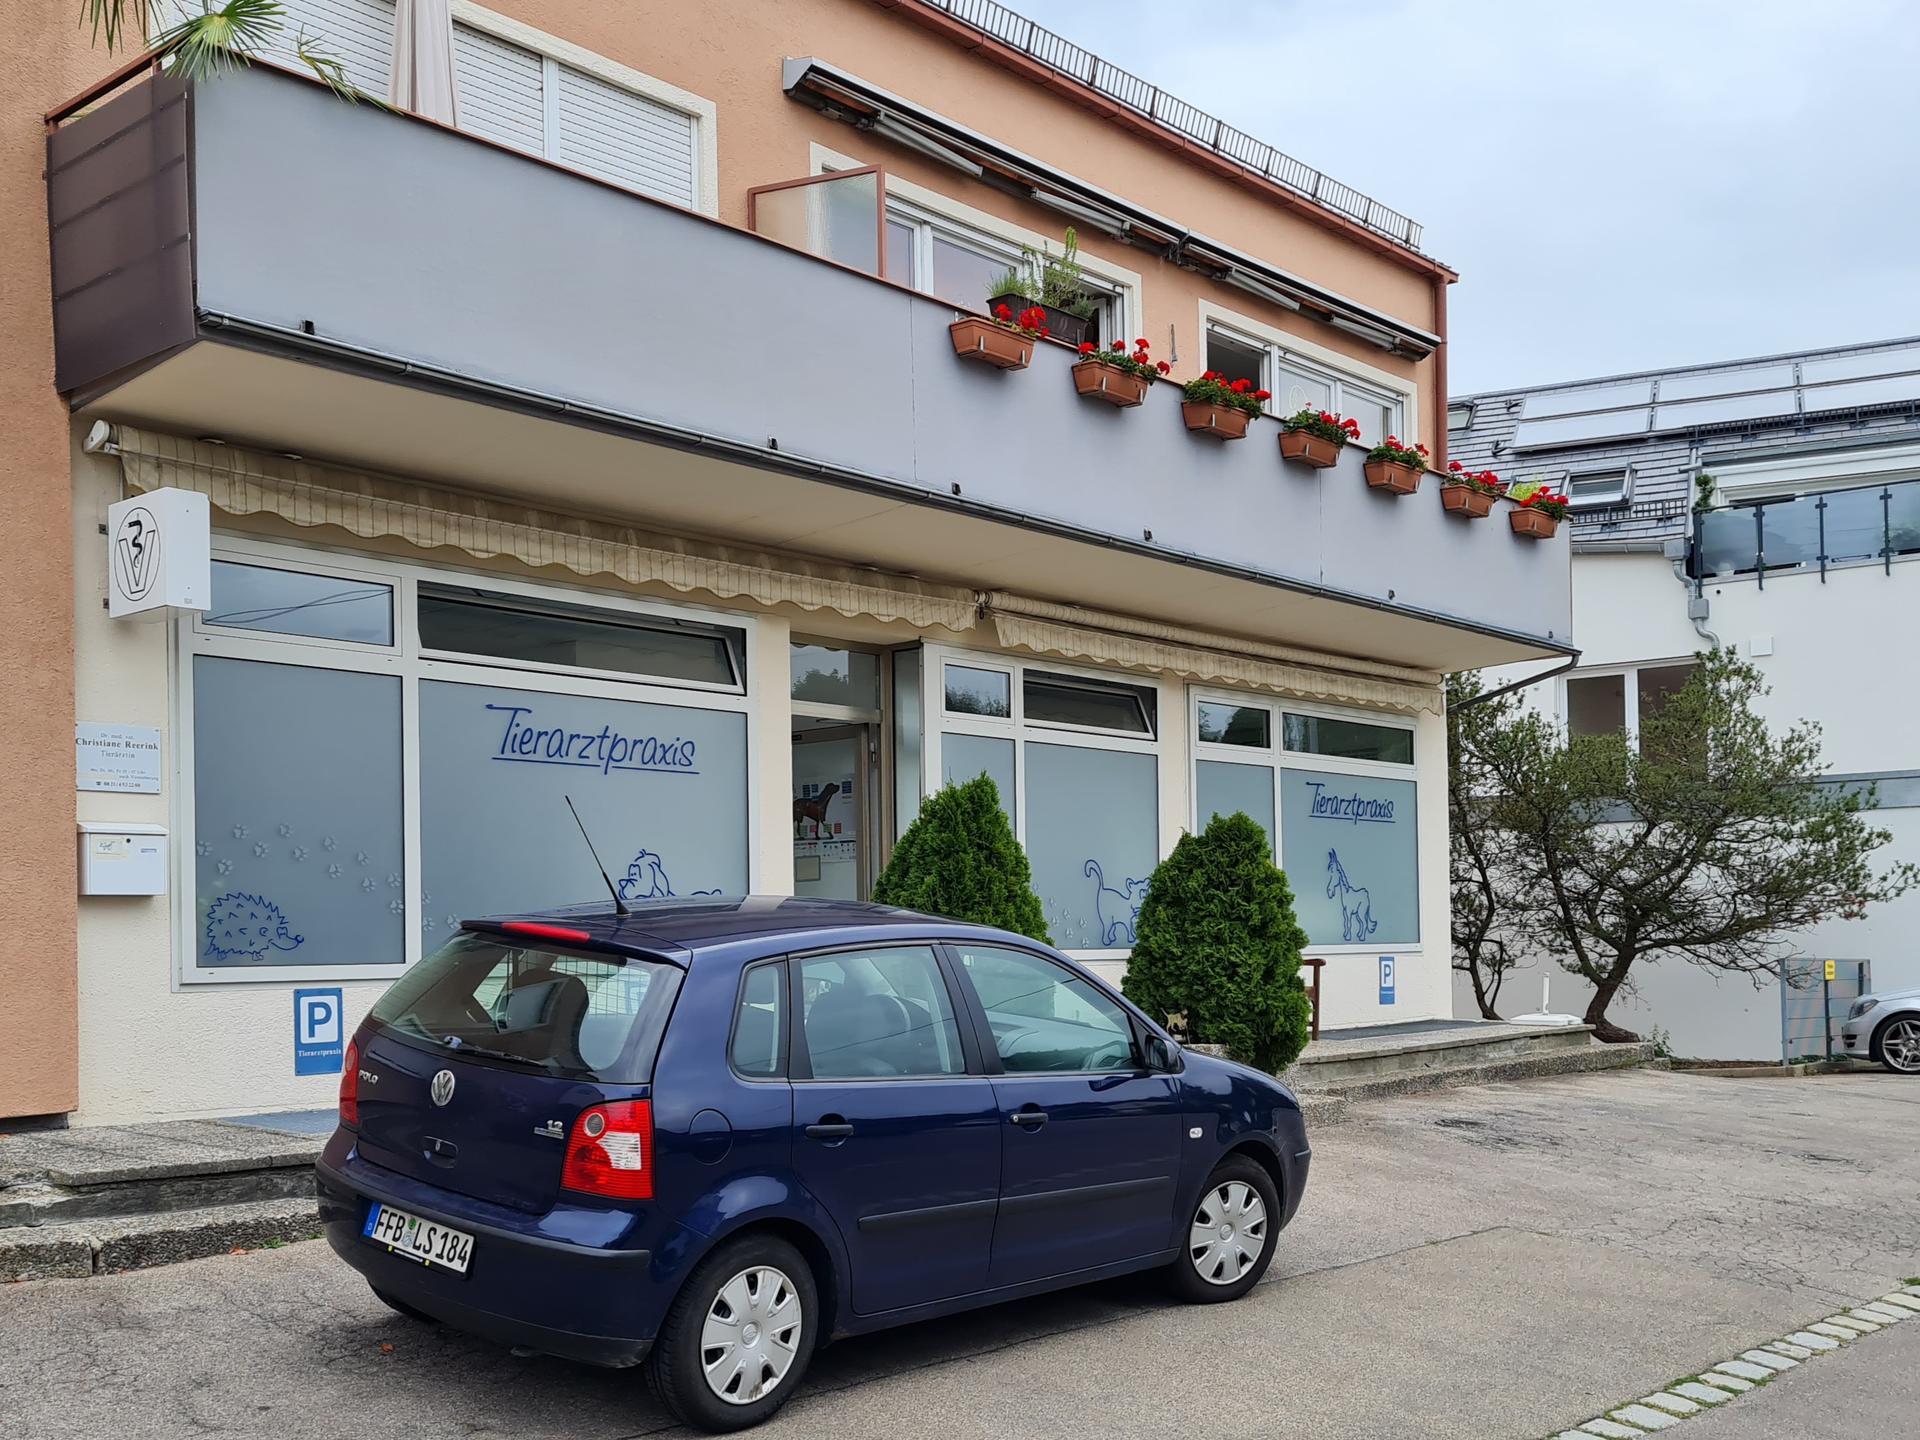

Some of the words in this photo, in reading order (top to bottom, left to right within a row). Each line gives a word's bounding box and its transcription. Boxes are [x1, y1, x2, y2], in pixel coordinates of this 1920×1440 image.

[75, 738, 121, 748] Christiane
[485, 703, 696, 775] Tierarztpraxis
[1306, 781, 1394, 825] Tierarztpraxis
[1383, 964, 1391, 984] P
[308, 1001, 332, 1038] P
[374, 1208, 406, 1242] FFB
